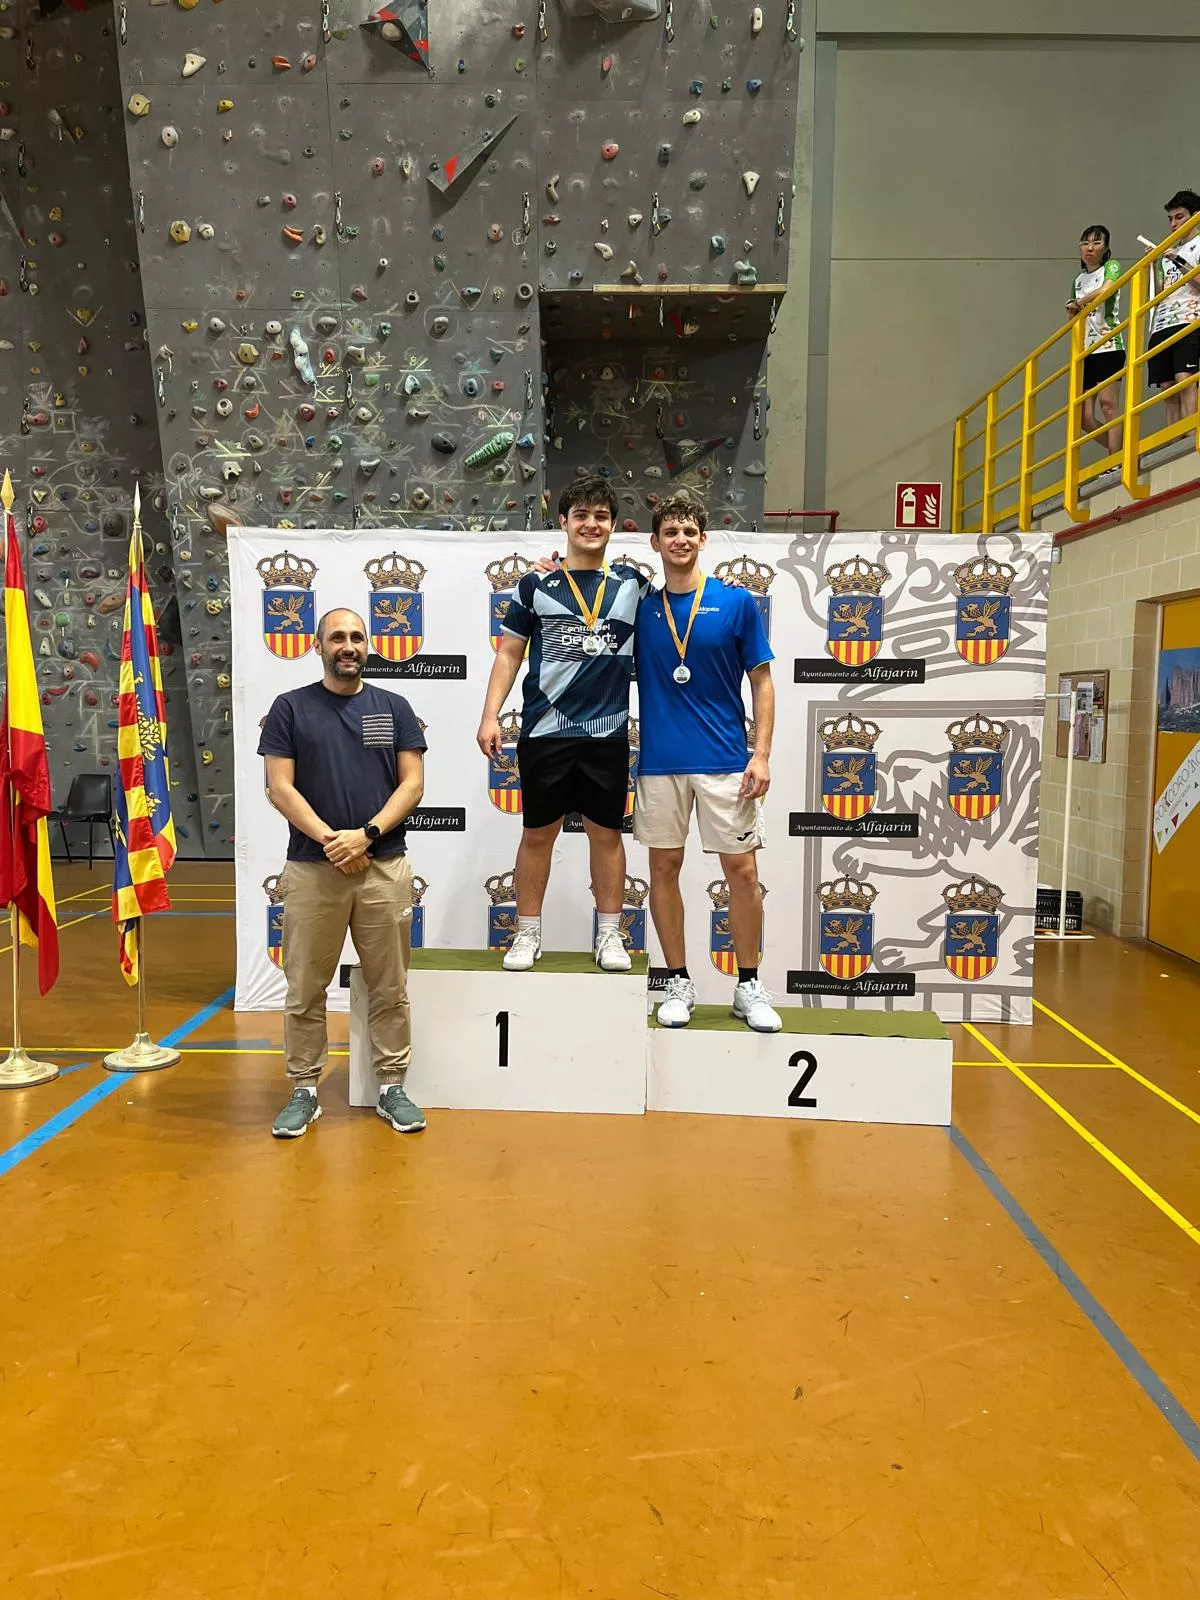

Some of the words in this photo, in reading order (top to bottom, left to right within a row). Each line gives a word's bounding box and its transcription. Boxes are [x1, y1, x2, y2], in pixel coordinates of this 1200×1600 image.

[794, 824, 844, 832] Ayuntamiento
[792, 981, 842, 990] Ayuntamiento
[496, 1011, 509, 1067] 1
[788, 1050, 818, 1108] 2
